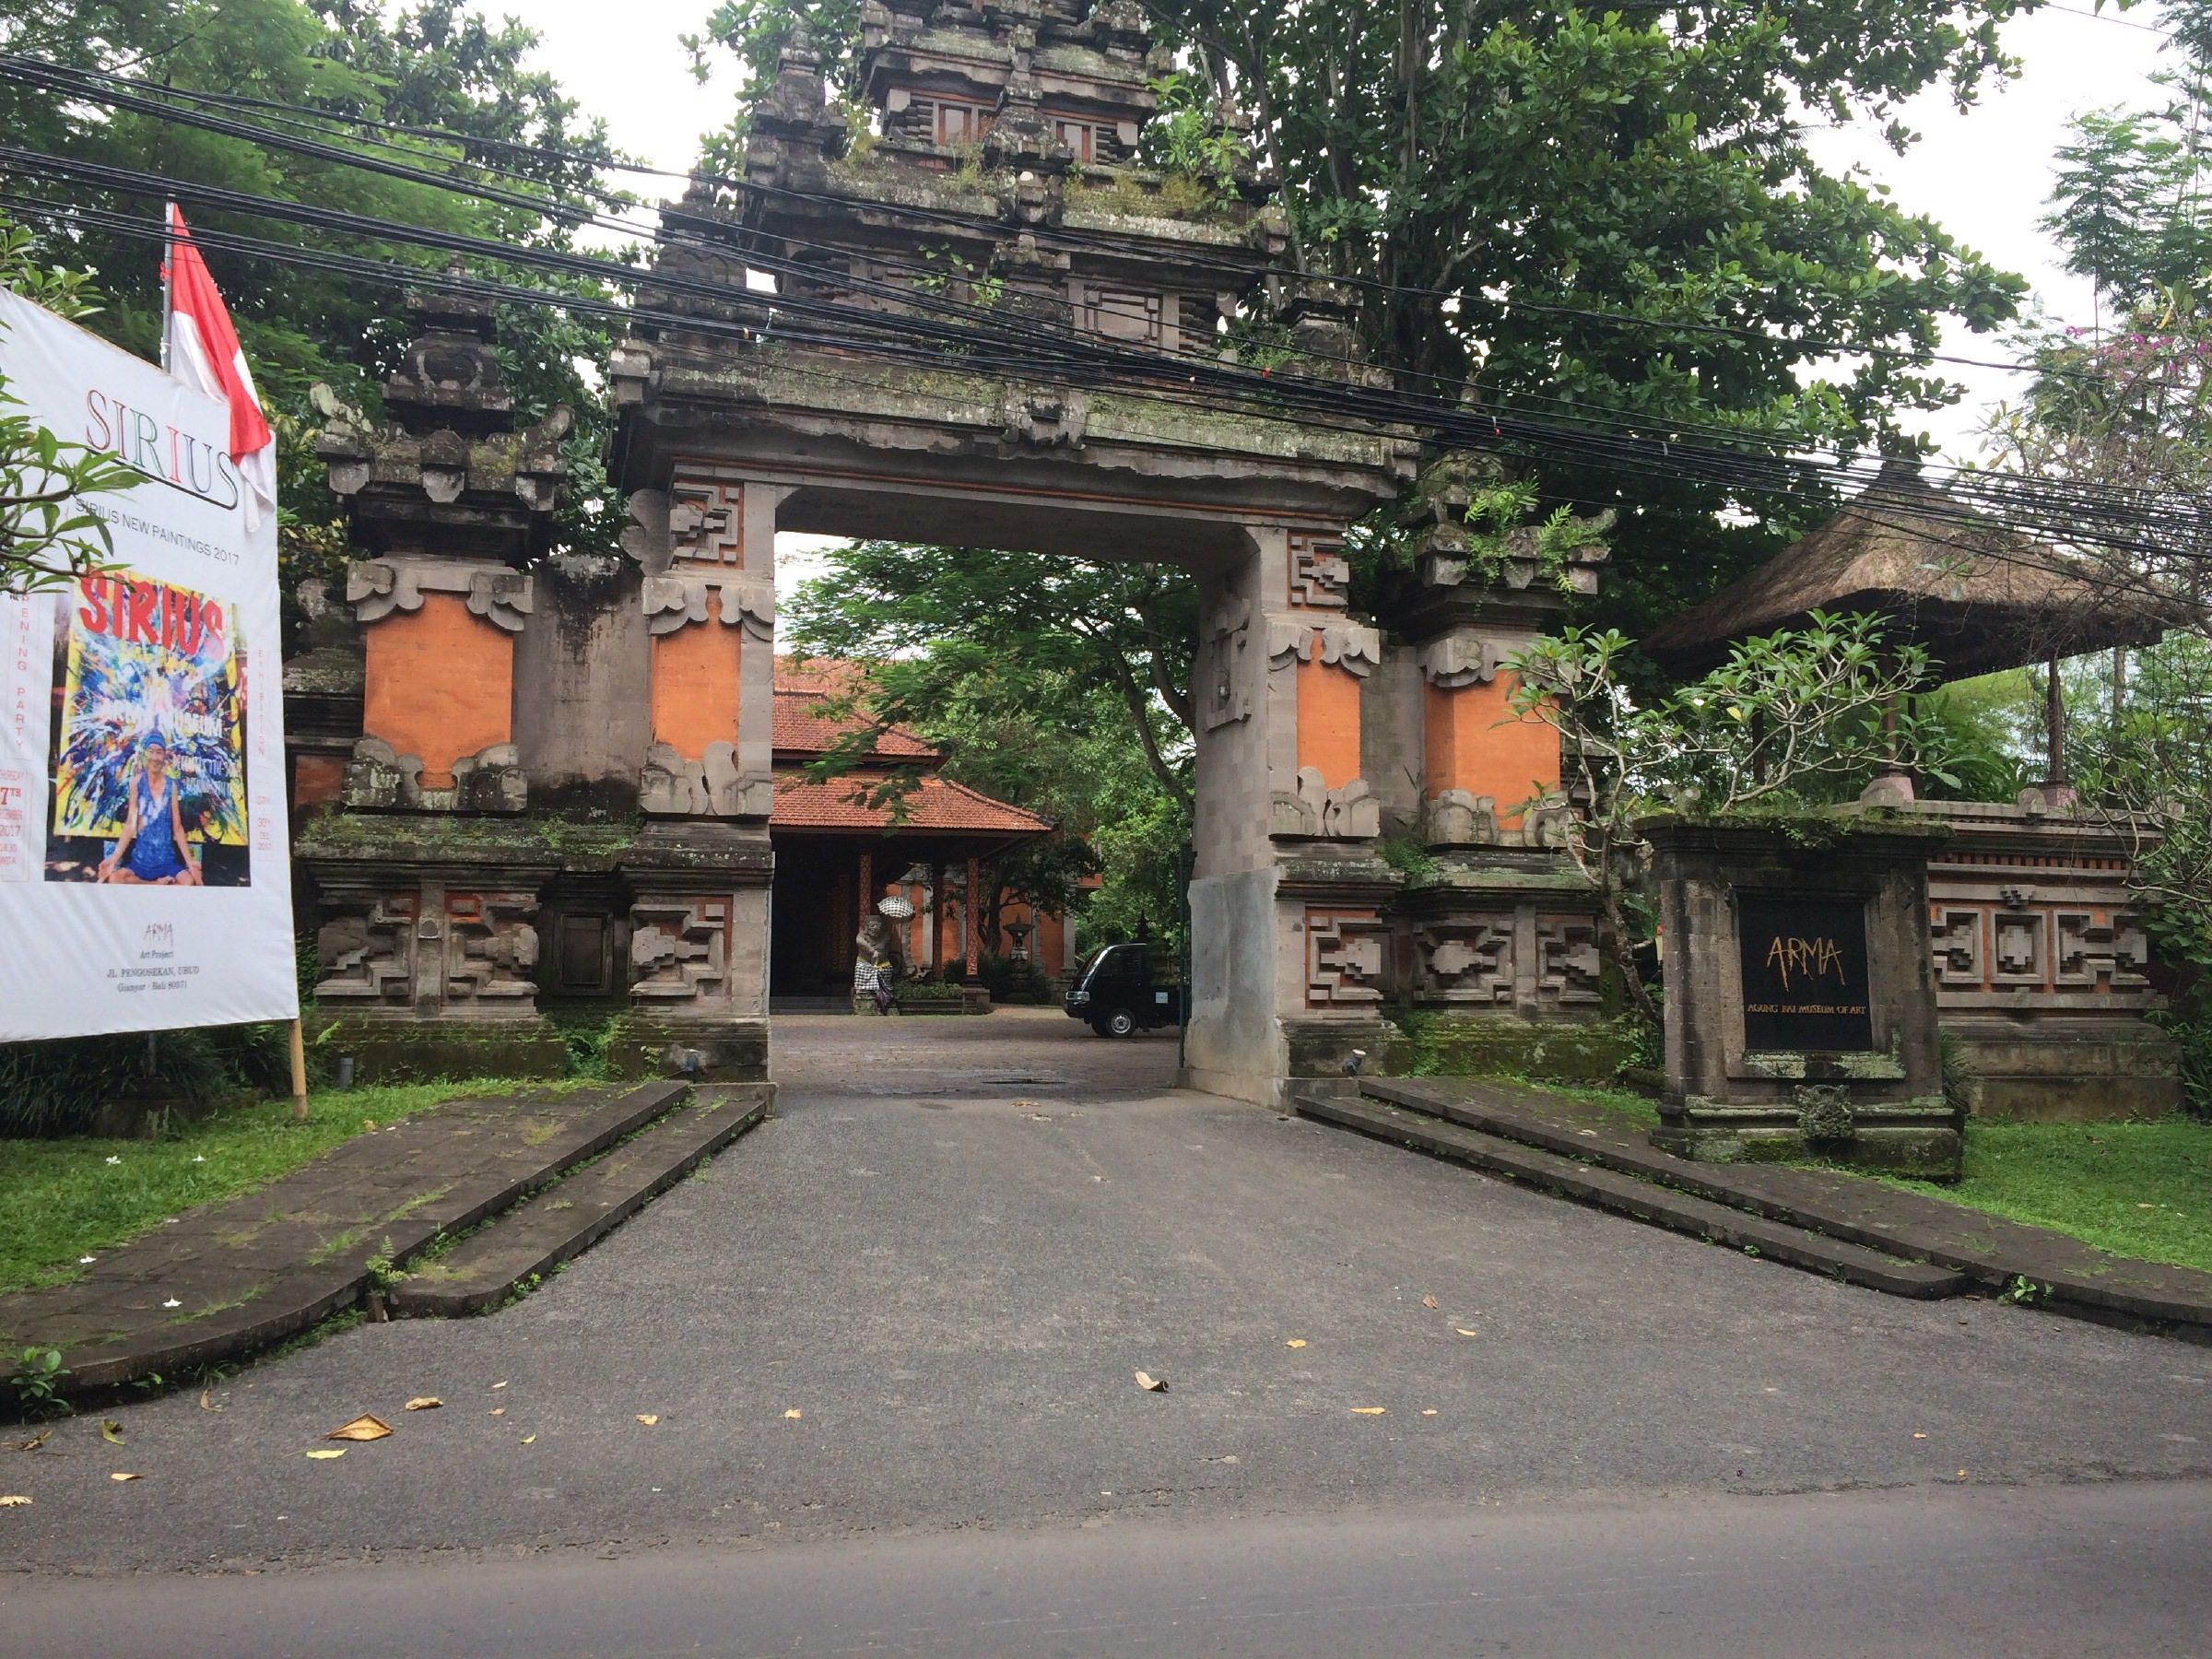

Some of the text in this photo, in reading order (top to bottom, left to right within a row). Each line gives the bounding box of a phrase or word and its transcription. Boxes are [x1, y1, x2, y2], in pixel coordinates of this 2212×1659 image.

[86, 389, 238, 510] SIRIUS
[76, 499, 240, 566] SIRIUS NEW PAINTINGS 2017
[79, 563, 224, 664] SIRIUS
[15, 687, 26, 749] PARTY
[143, 923, 173, 947] ARMA
[152, 950, 173, 959] Project
[177, 966, 200, 975] UBUD
[1766, 935, 1846, 993] ARMA
[117, 982, 146, 993] Gianyar
[152, 981, 166, 990] Bali
[1747, 1004, 1865, 1015] AGUNG RAI MUSEUM OF ART
